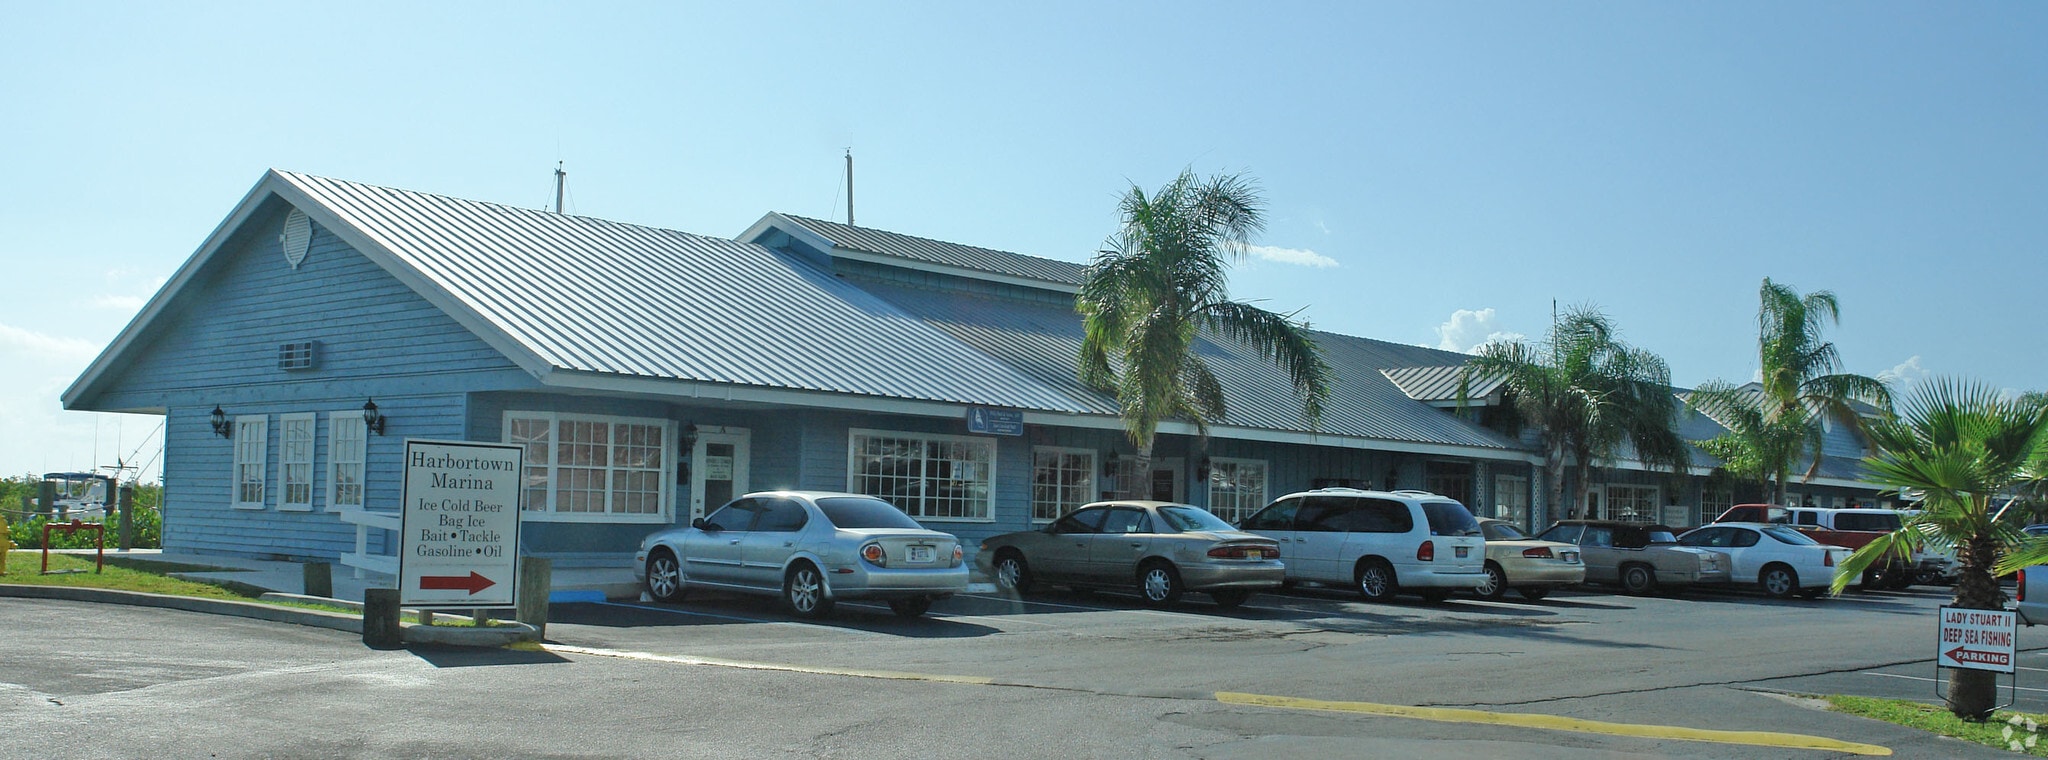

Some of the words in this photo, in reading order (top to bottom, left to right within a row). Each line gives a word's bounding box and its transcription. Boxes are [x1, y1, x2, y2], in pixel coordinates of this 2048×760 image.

[411, 451, 514, 472] Harbortown
[430, 472, 493, 490] Marina
[419, 498, 438, 511] Ice
[441, 499, 470, 512] Cold
[475, 500, 503, 513] Beer
[439, 514, 463, 529] Bag
[467, 515, 485, 527] Ice
[421, 529, 447, 542] Bait
[459, 530, 500, 542] Tackle
[417, 545, 472, 557] Gasoline
[483, 545, 502, 557] Oil
[1946, 612, 1967, 624] LADY
[1970, 613, 2002, 626] STUART
[1943, 627, 1962, 643] DEEP
[1964, 630, 1979, 644] SEA
[1981, 630, 2011, 647] FISHING
[1956, 651, 2008, 663] PARKING
